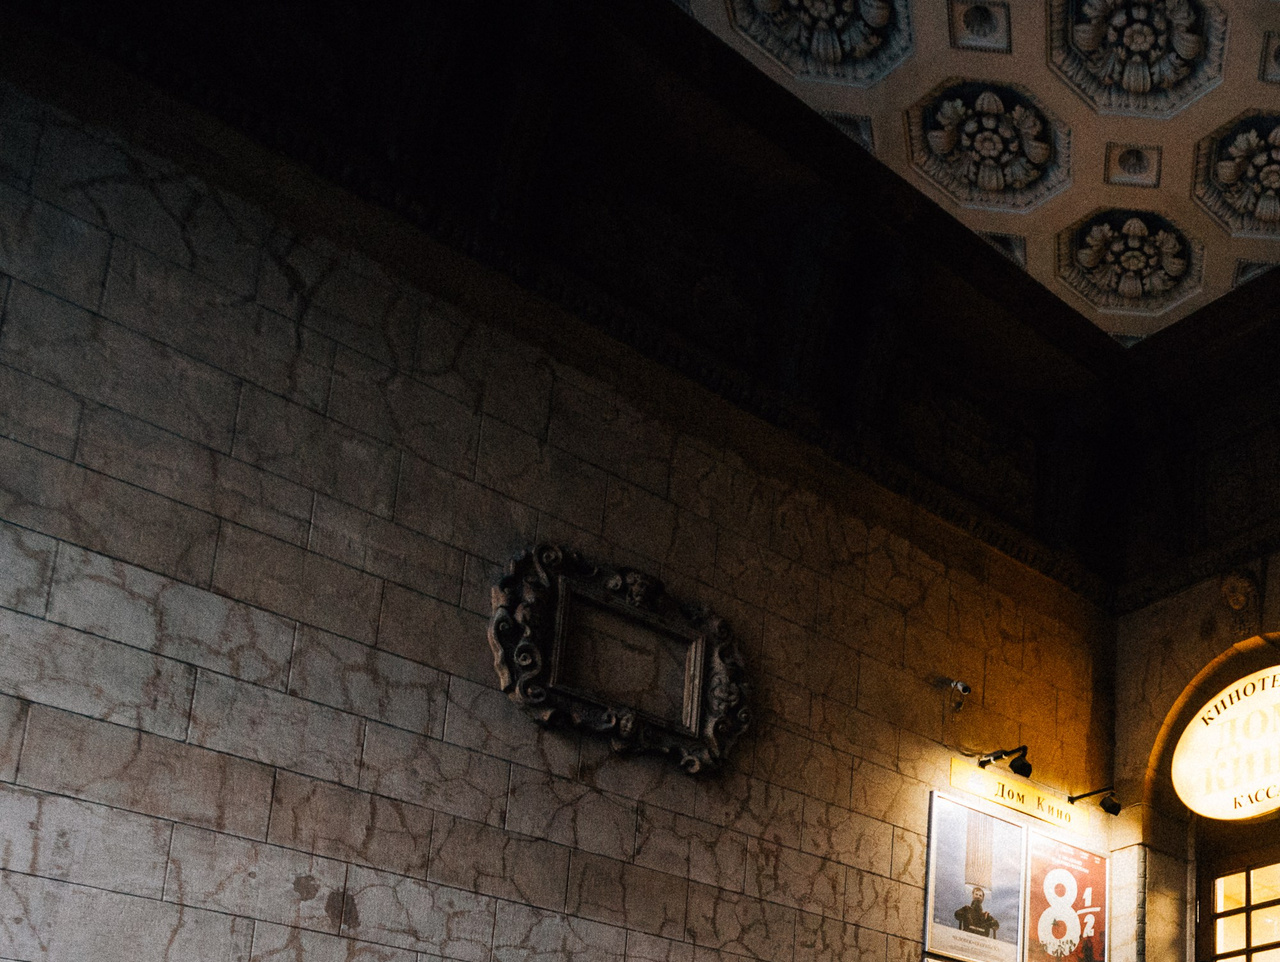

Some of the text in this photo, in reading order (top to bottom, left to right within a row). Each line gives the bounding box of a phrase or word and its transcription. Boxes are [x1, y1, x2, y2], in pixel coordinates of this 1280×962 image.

[994, 781, 1071, 823] Дом Кино
[1037, 868, 1082, 957] 8
